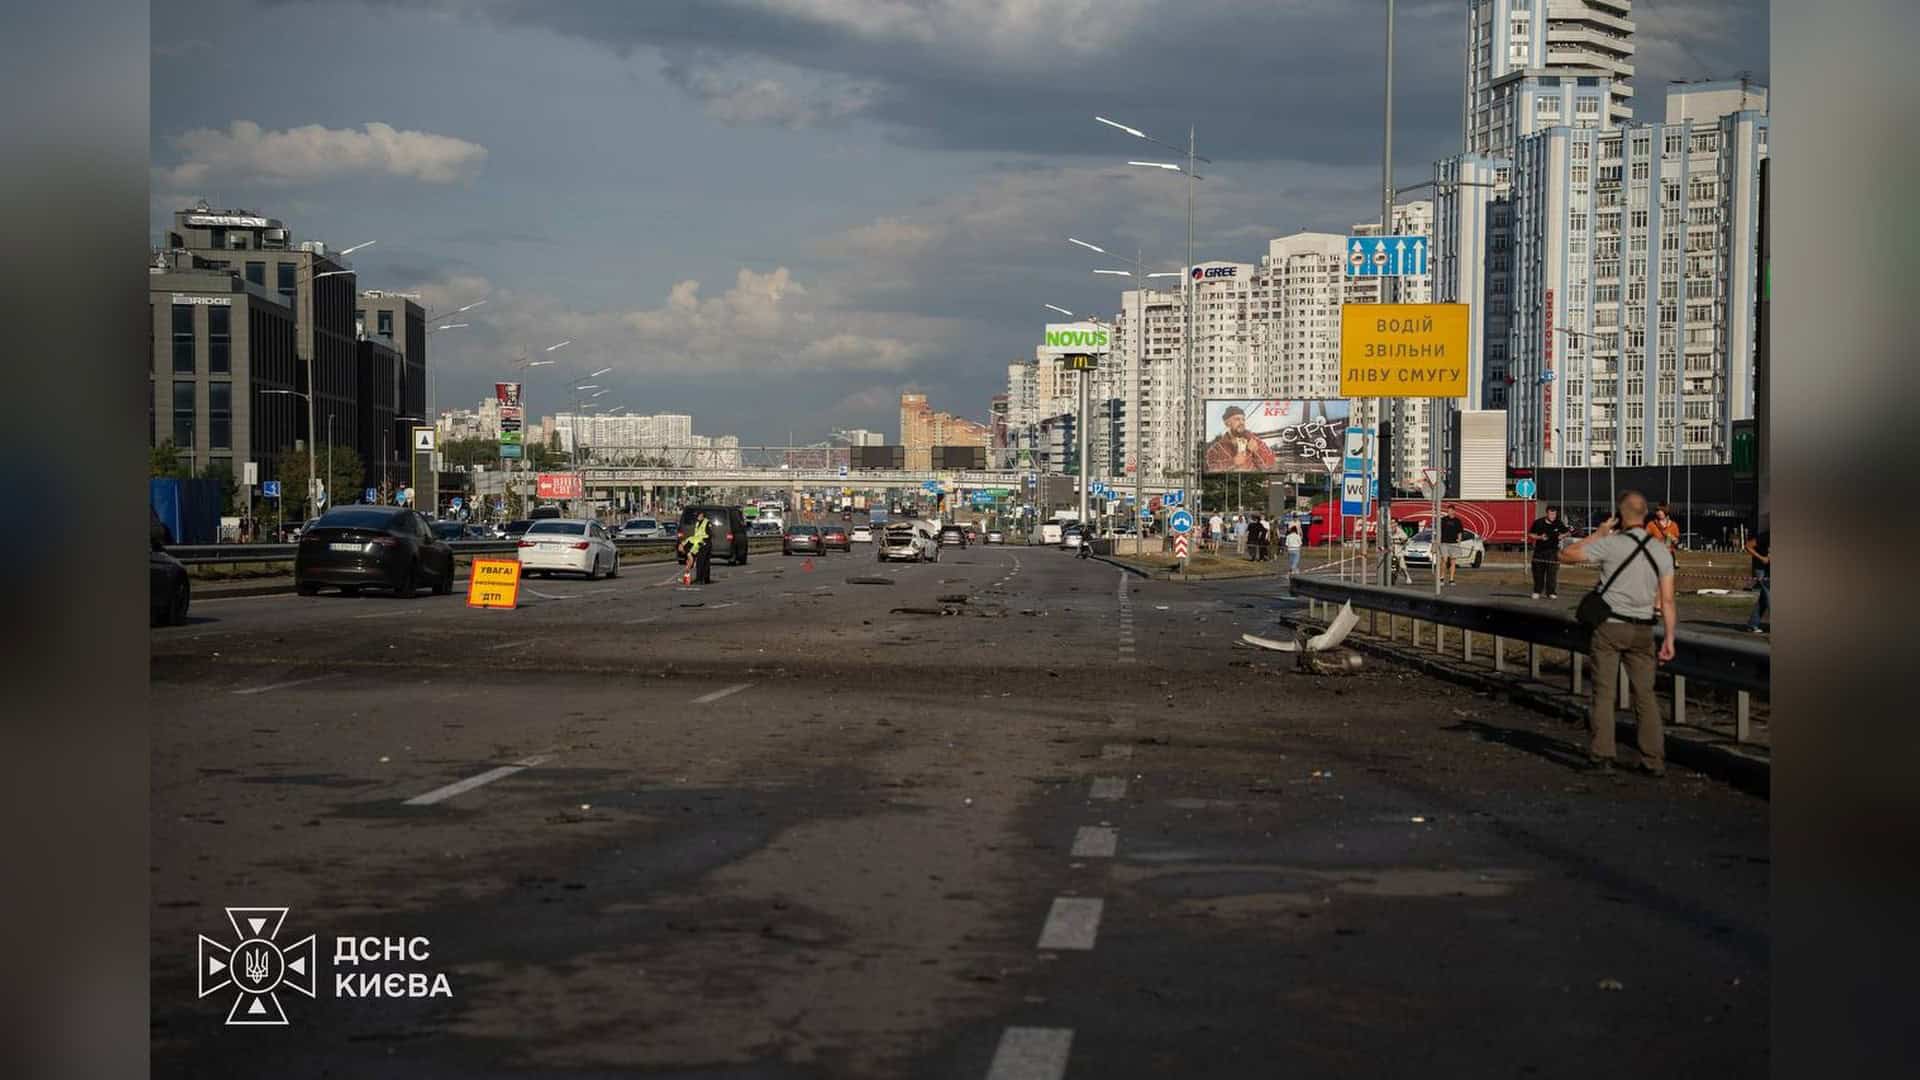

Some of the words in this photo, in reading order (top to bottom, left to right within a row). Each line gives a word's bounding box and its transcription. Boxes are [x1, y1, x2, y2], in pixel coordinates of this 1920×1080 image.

[1204, 266, 1237, 277] GREE
[1376, 315, 1433, 334] ВОДІЙ
[1047, 331, 1107, 346] NOVUS
[1365, 344, 1444, 357] ЗВІЛЬНИ
[1348, 368, 1390, 382] ЛІВУ
[1398, 368, 1461, 382] СМУГУ
[1264, 408, 1289, 416] KFC
[480, 566, 513, 575] УВАГА!
[483, 593, 502, 601] ДТП
